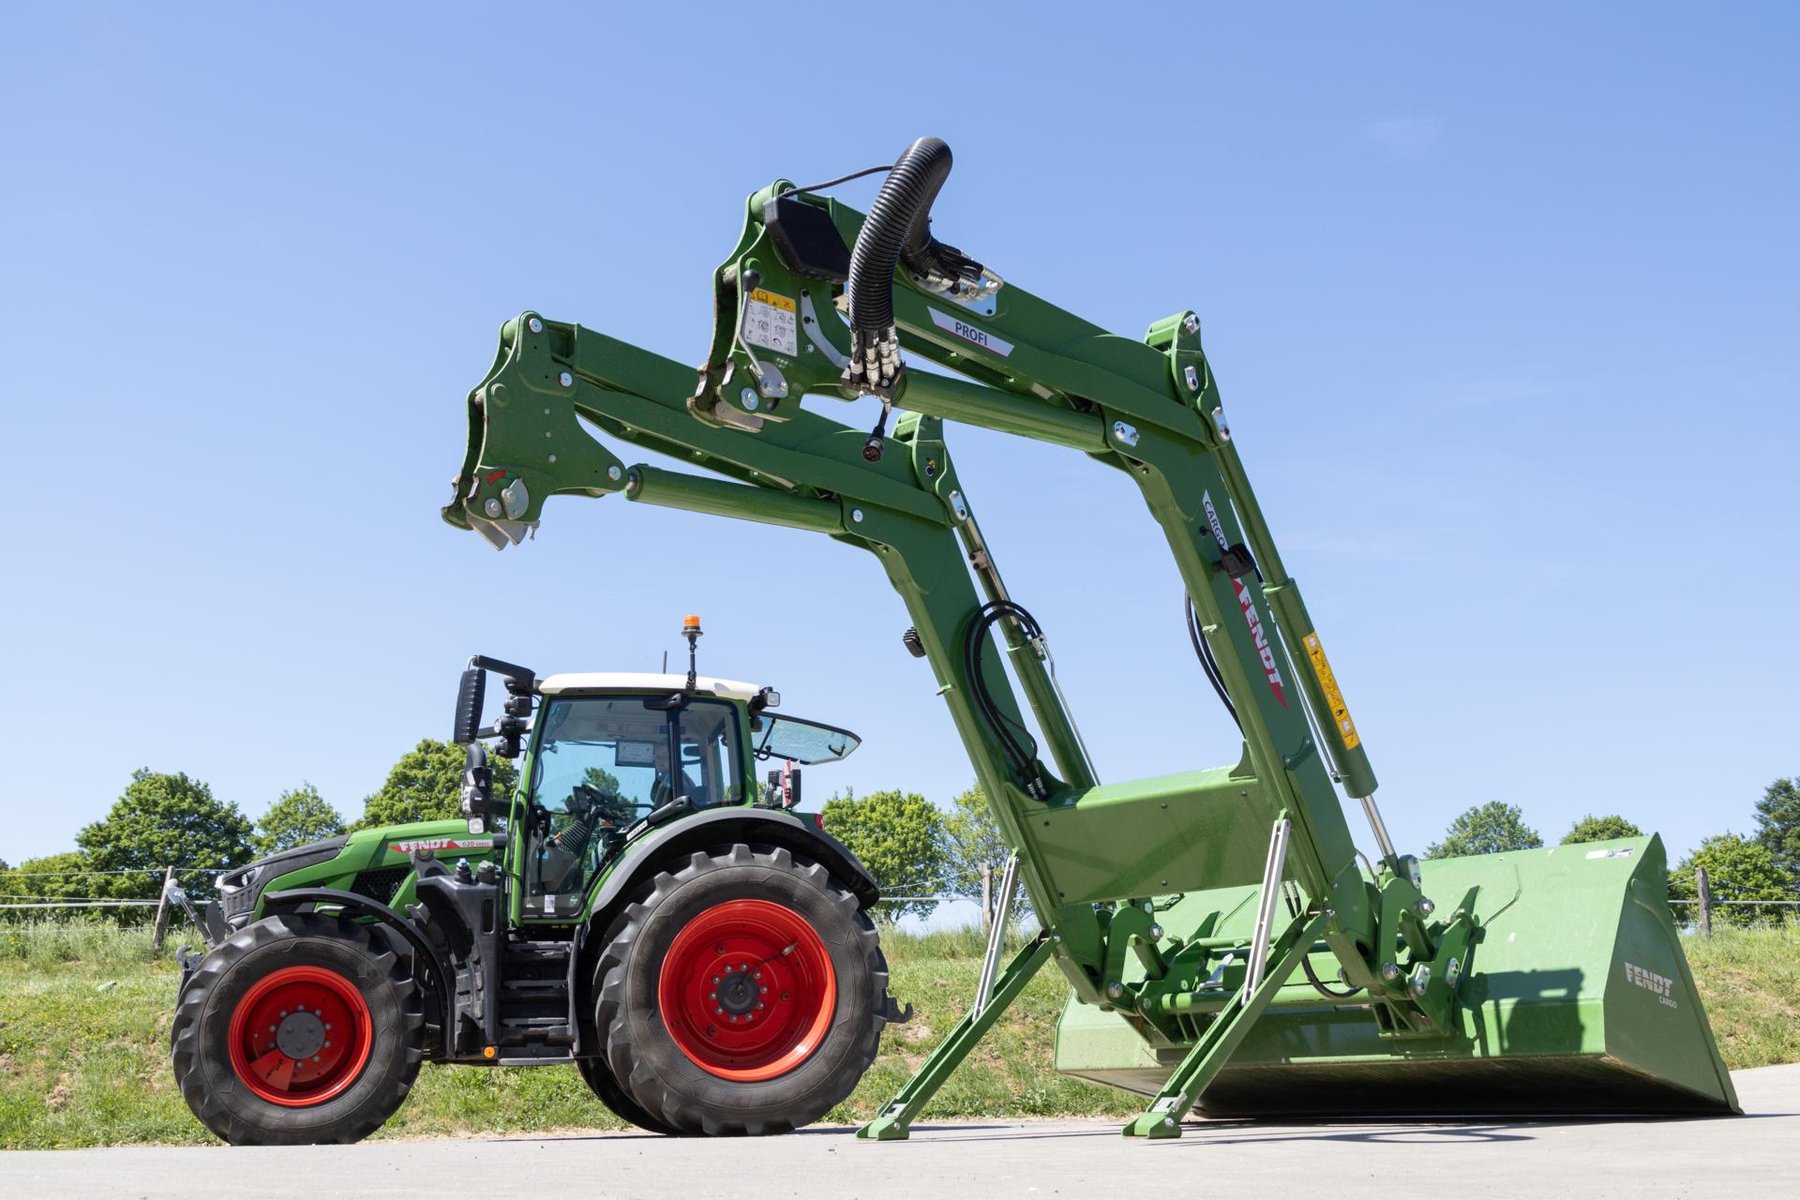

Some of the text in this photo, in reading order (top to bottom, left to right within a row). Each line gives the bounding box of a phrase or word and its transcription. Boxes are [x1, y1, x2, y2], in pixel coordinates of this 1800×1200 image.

[955, 321, 988, 346] PROFI
[1205, 501, 1225, 546] CARGO
[1239, 585, 1284, 687] FENDT
[399, 838, 452, 853] FENDT
[1624, 962, 1673, 997] FENDT
[1658, 996, 1678, 1009] CARGO
